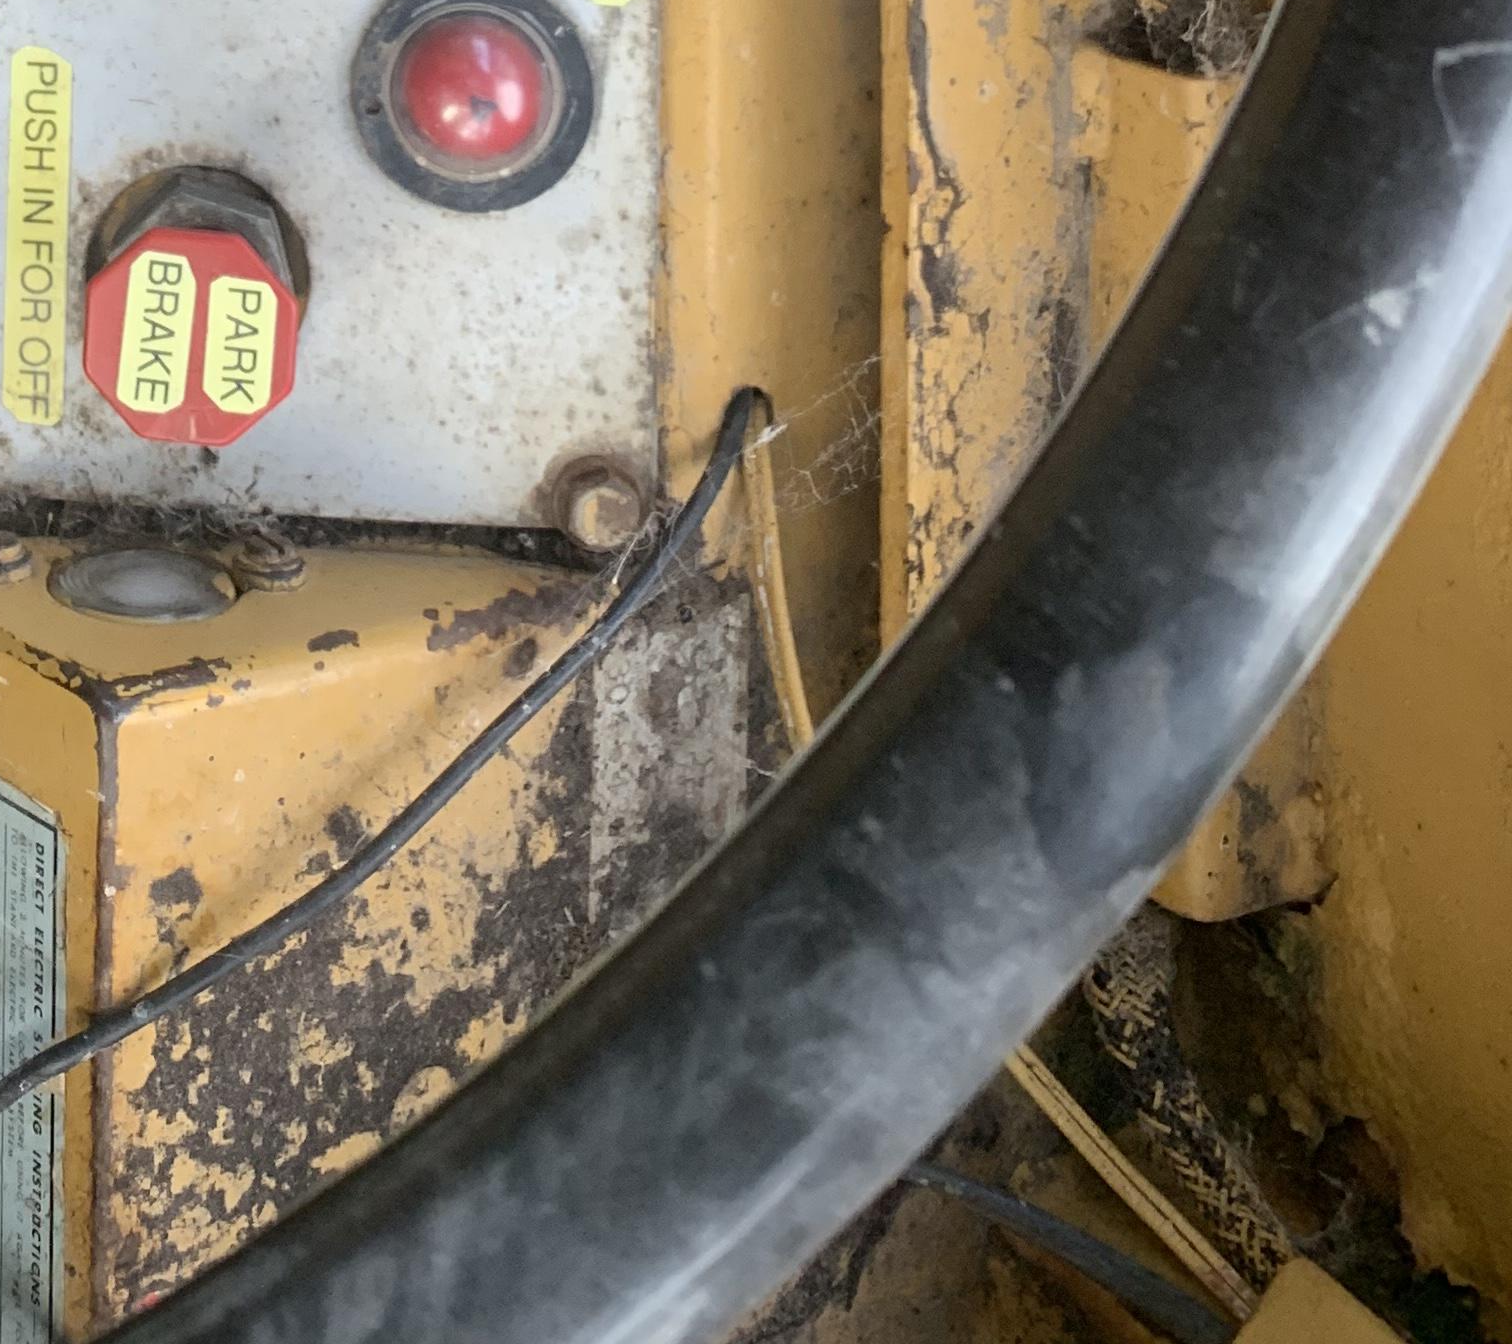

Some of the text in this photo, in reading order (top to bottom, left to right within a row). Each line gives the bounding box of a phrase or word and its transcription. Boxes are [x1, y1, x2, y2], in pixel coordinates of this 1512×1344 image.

[16, 60, 60, 420] PUSH IN FOR OFF
[132, 258, 183, 406] BRAKE
[219, 286, 263, 406] PARK
[34, 841, 46, 916] DIRECT
[33, 925, 45, 1020] ELECTRIC
